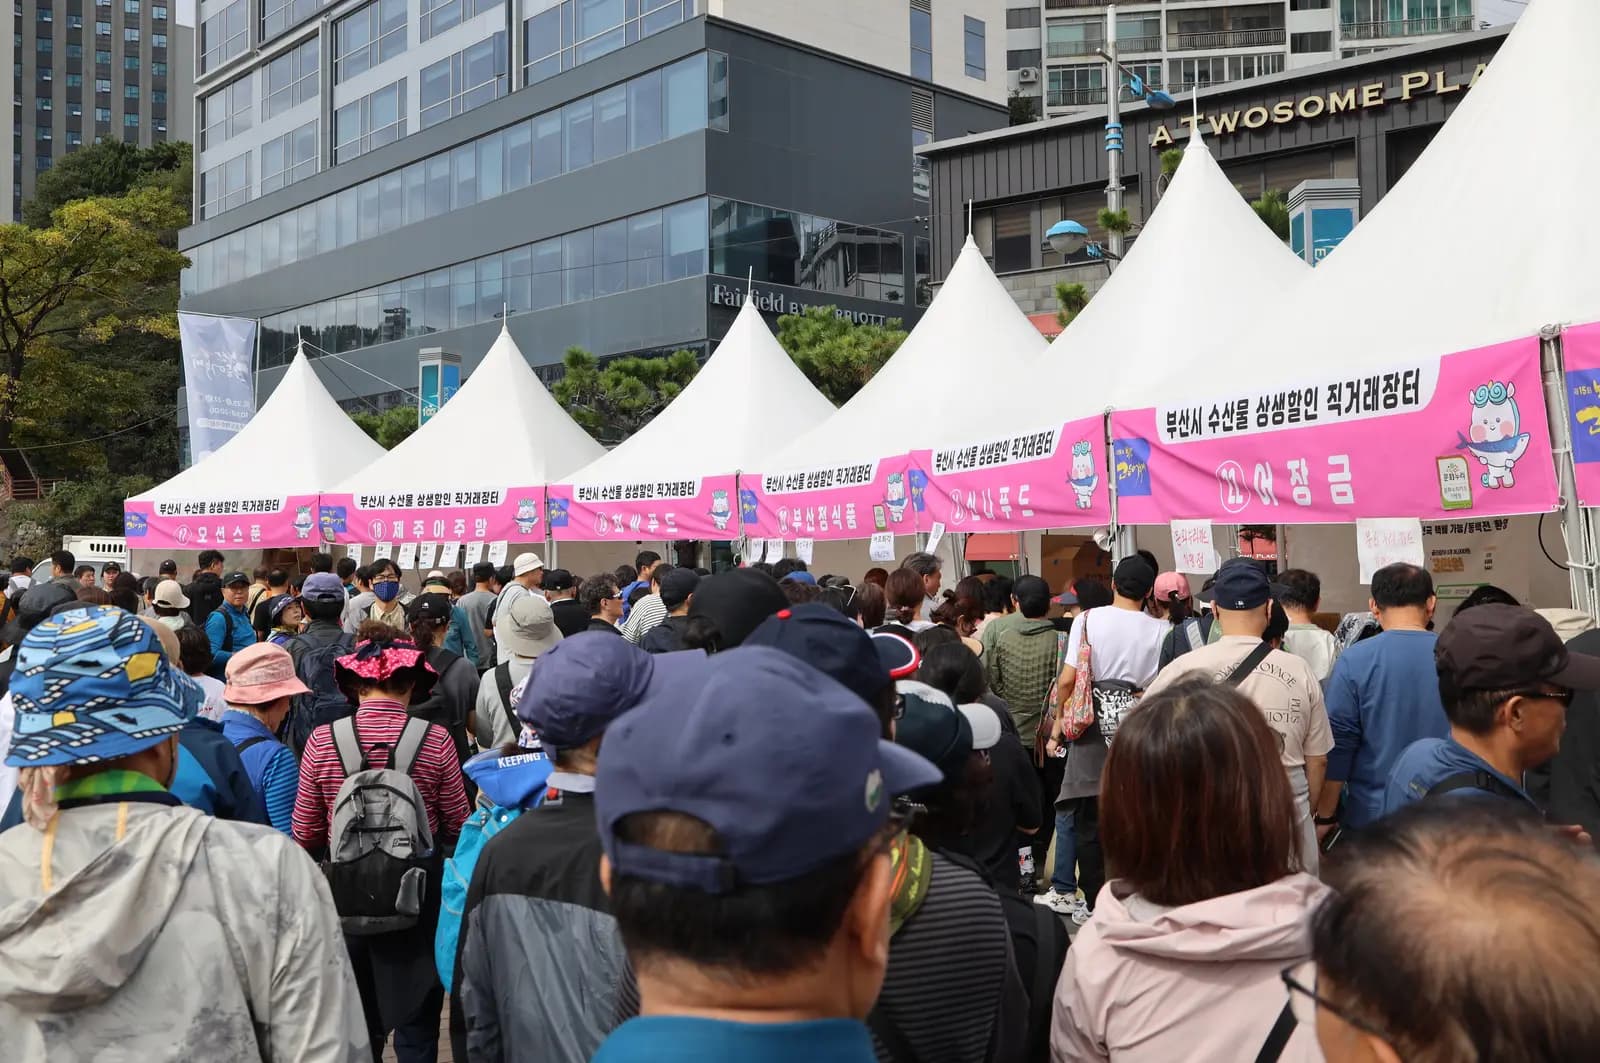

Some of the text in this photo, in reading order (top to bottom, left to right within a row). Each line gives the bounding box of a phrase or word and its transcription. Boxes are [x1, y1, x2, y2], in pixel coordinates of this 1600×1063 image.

[1151, 125, 1174, 148] A
[1180, 82, 1385, 136] TWOSOME
[790, 302, 808, 316] BY
[1166, 368, 1420, 439] 부산시 수산물 상생할인 직거래장터
[936, 429, 1055, 473] 부산시 수산물 상생할인 직거래장터
[766, 464, 873, 493] 부산시 수산물 상생할인 직거래장터
[360, 491, 499, 508] 부산시 수산물 상생할인 직거래장터
[578, 480, 696, 501] 부산시 수산물 상생할인 직거래장터
[160, 499, 280, 515] 부산시 수산물 상생할인 직거래장터
[1254, 662, 1297, 688] OYAGE
[498, 752, 541, 769] KEEPING
